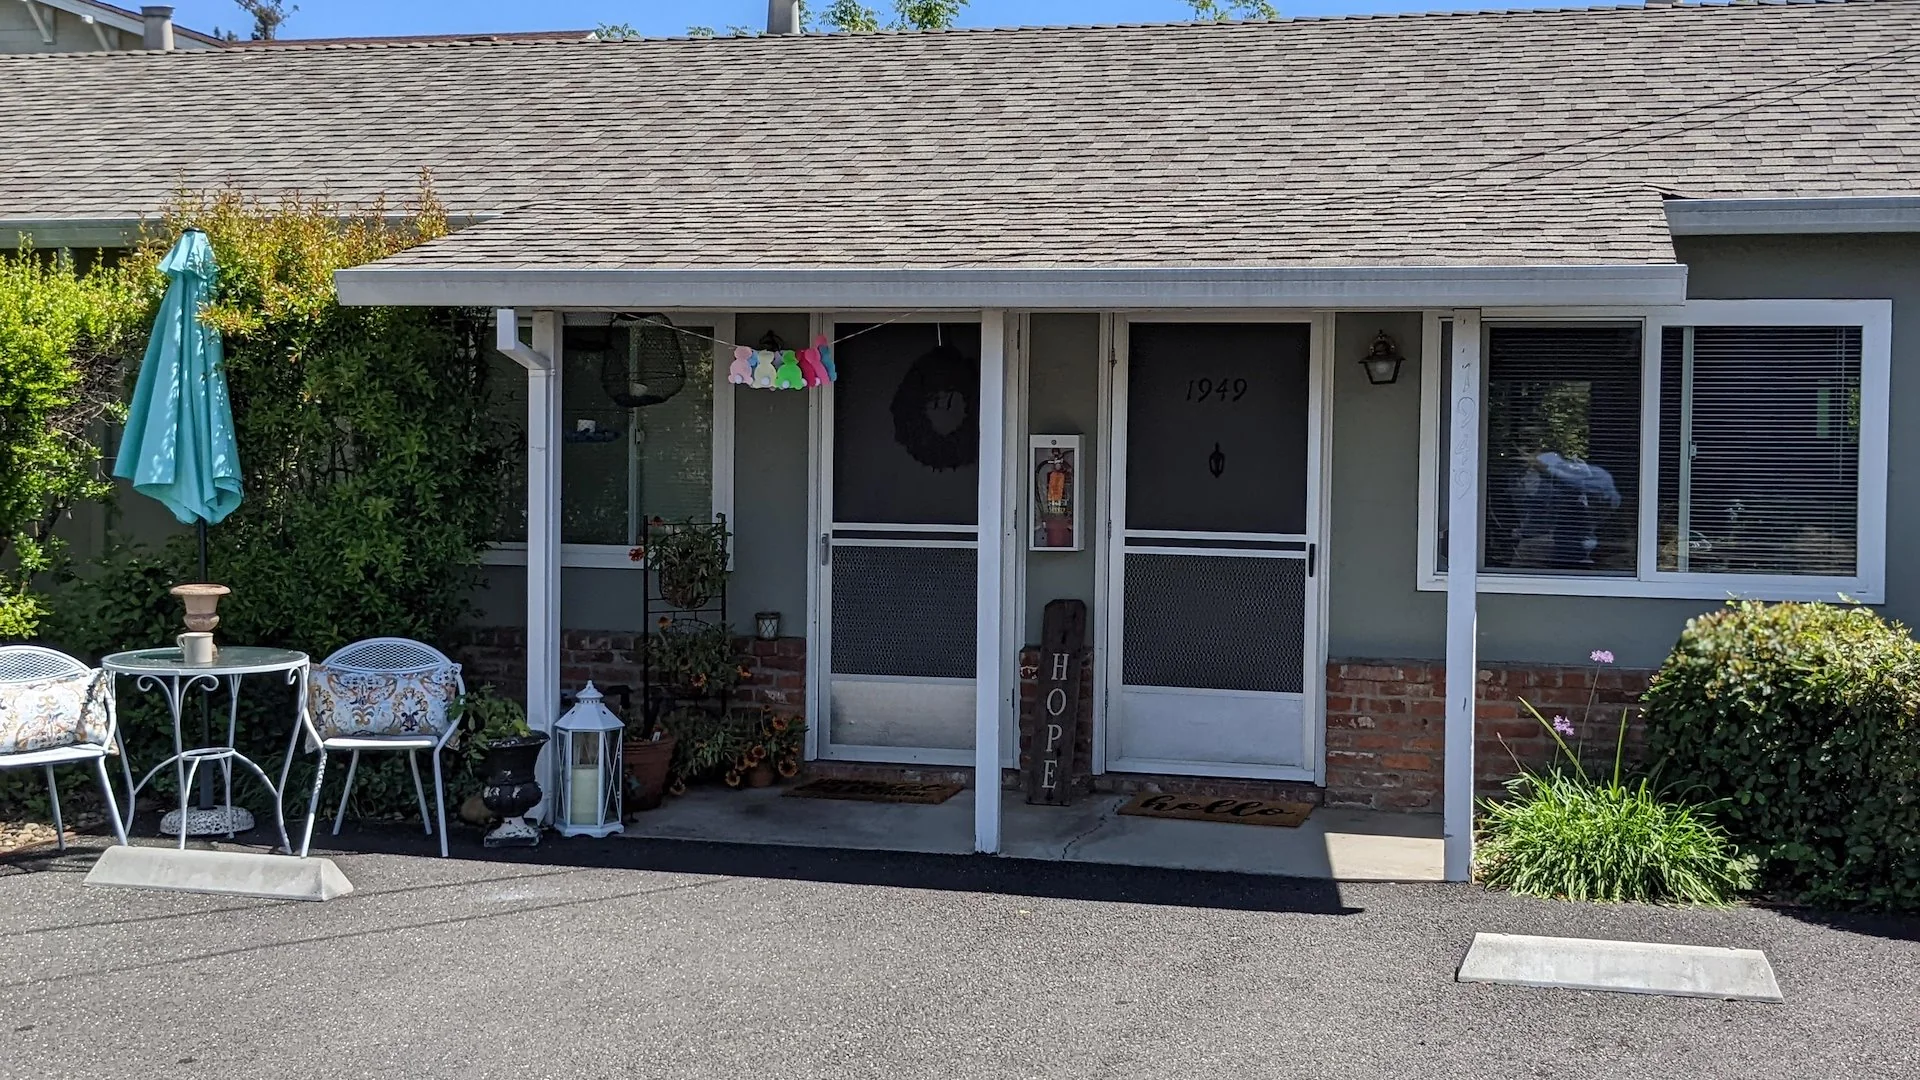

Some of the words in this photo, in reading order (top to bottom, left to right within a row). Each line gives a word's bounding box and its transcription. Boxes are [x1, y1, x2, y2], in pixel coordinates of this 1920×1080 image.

[1186, 377, 1248, 404] 1949
[1040, 652, 1070, 790] HOPE
[1139, 794, 1297, 817] hello
